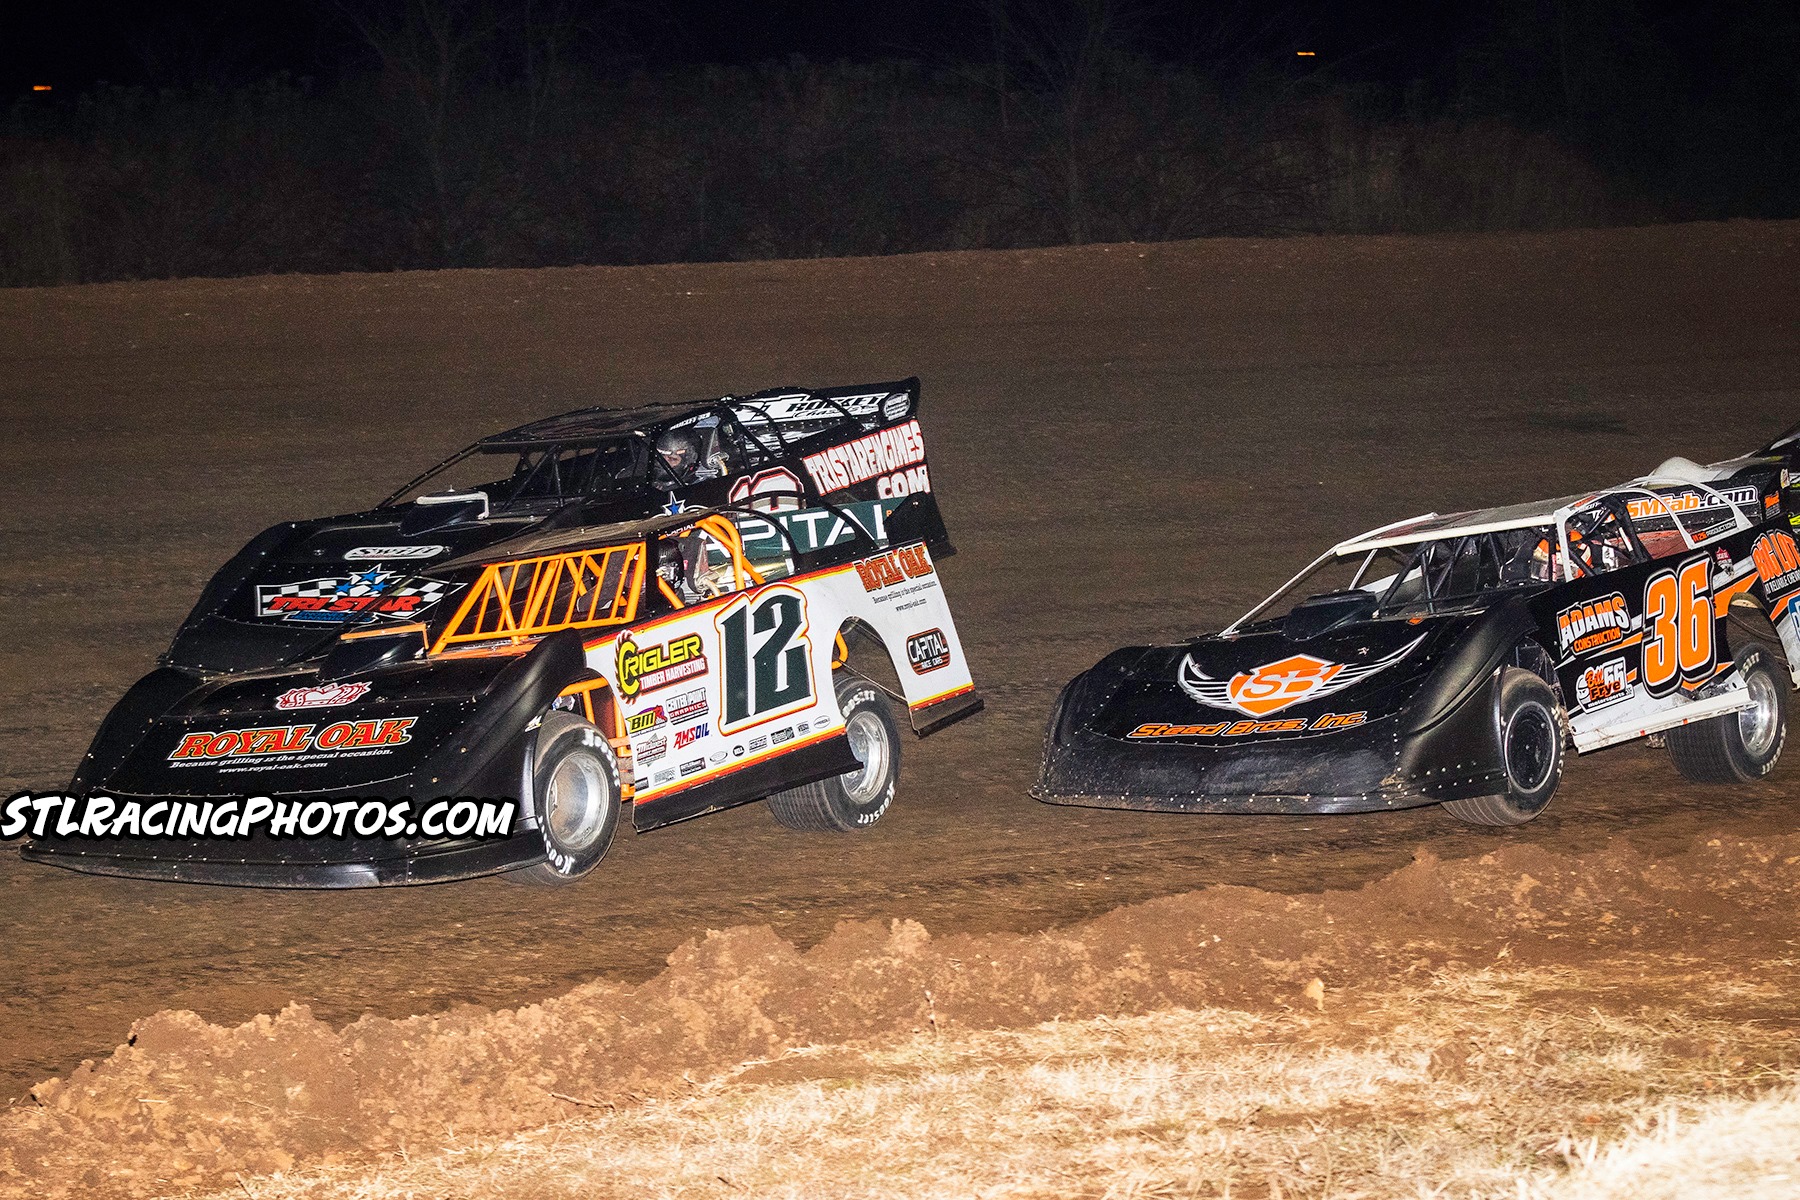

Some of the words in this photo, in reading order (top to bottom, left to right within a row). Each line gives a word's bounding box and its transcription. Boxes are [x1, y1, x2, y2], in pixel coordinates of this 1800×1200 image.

[853, 552, 907, 592] ROYAL
[897, 544, 934, 579] OAK
[268, 596, 332, 610] TRI
[1559, 596, 1630, 650] ADAMS
[1645, 557, 1711, 687] 36
[907, 632, 949, 663] CAPITAL
[1573, 626, 1621, 653] CONSTRUCTION
[641, 671, 666, 690] TIMBER
[665, 659, 706, 681] HARVESTING
[719, 593, 812, 726] 12
[1589, 680, 1622, 702] Frye
[168, 724, 315, 760] ROYAL
[315, 717, 418, 750] OAK
[673, 722, 710, 750] AMSOIL
[1127, 722, 1224, 738] Steed
[1221, 718, 1308, 737] Bros.
[1310, 711, 1368, 731] Inc.
[169, 759, 218, 769] Because
[217, 755, 263, 767] grilling
[273, 754, 295, 762] the
[294, 751, 339, 763] special
[339, 747, 394, 758] occasion.
